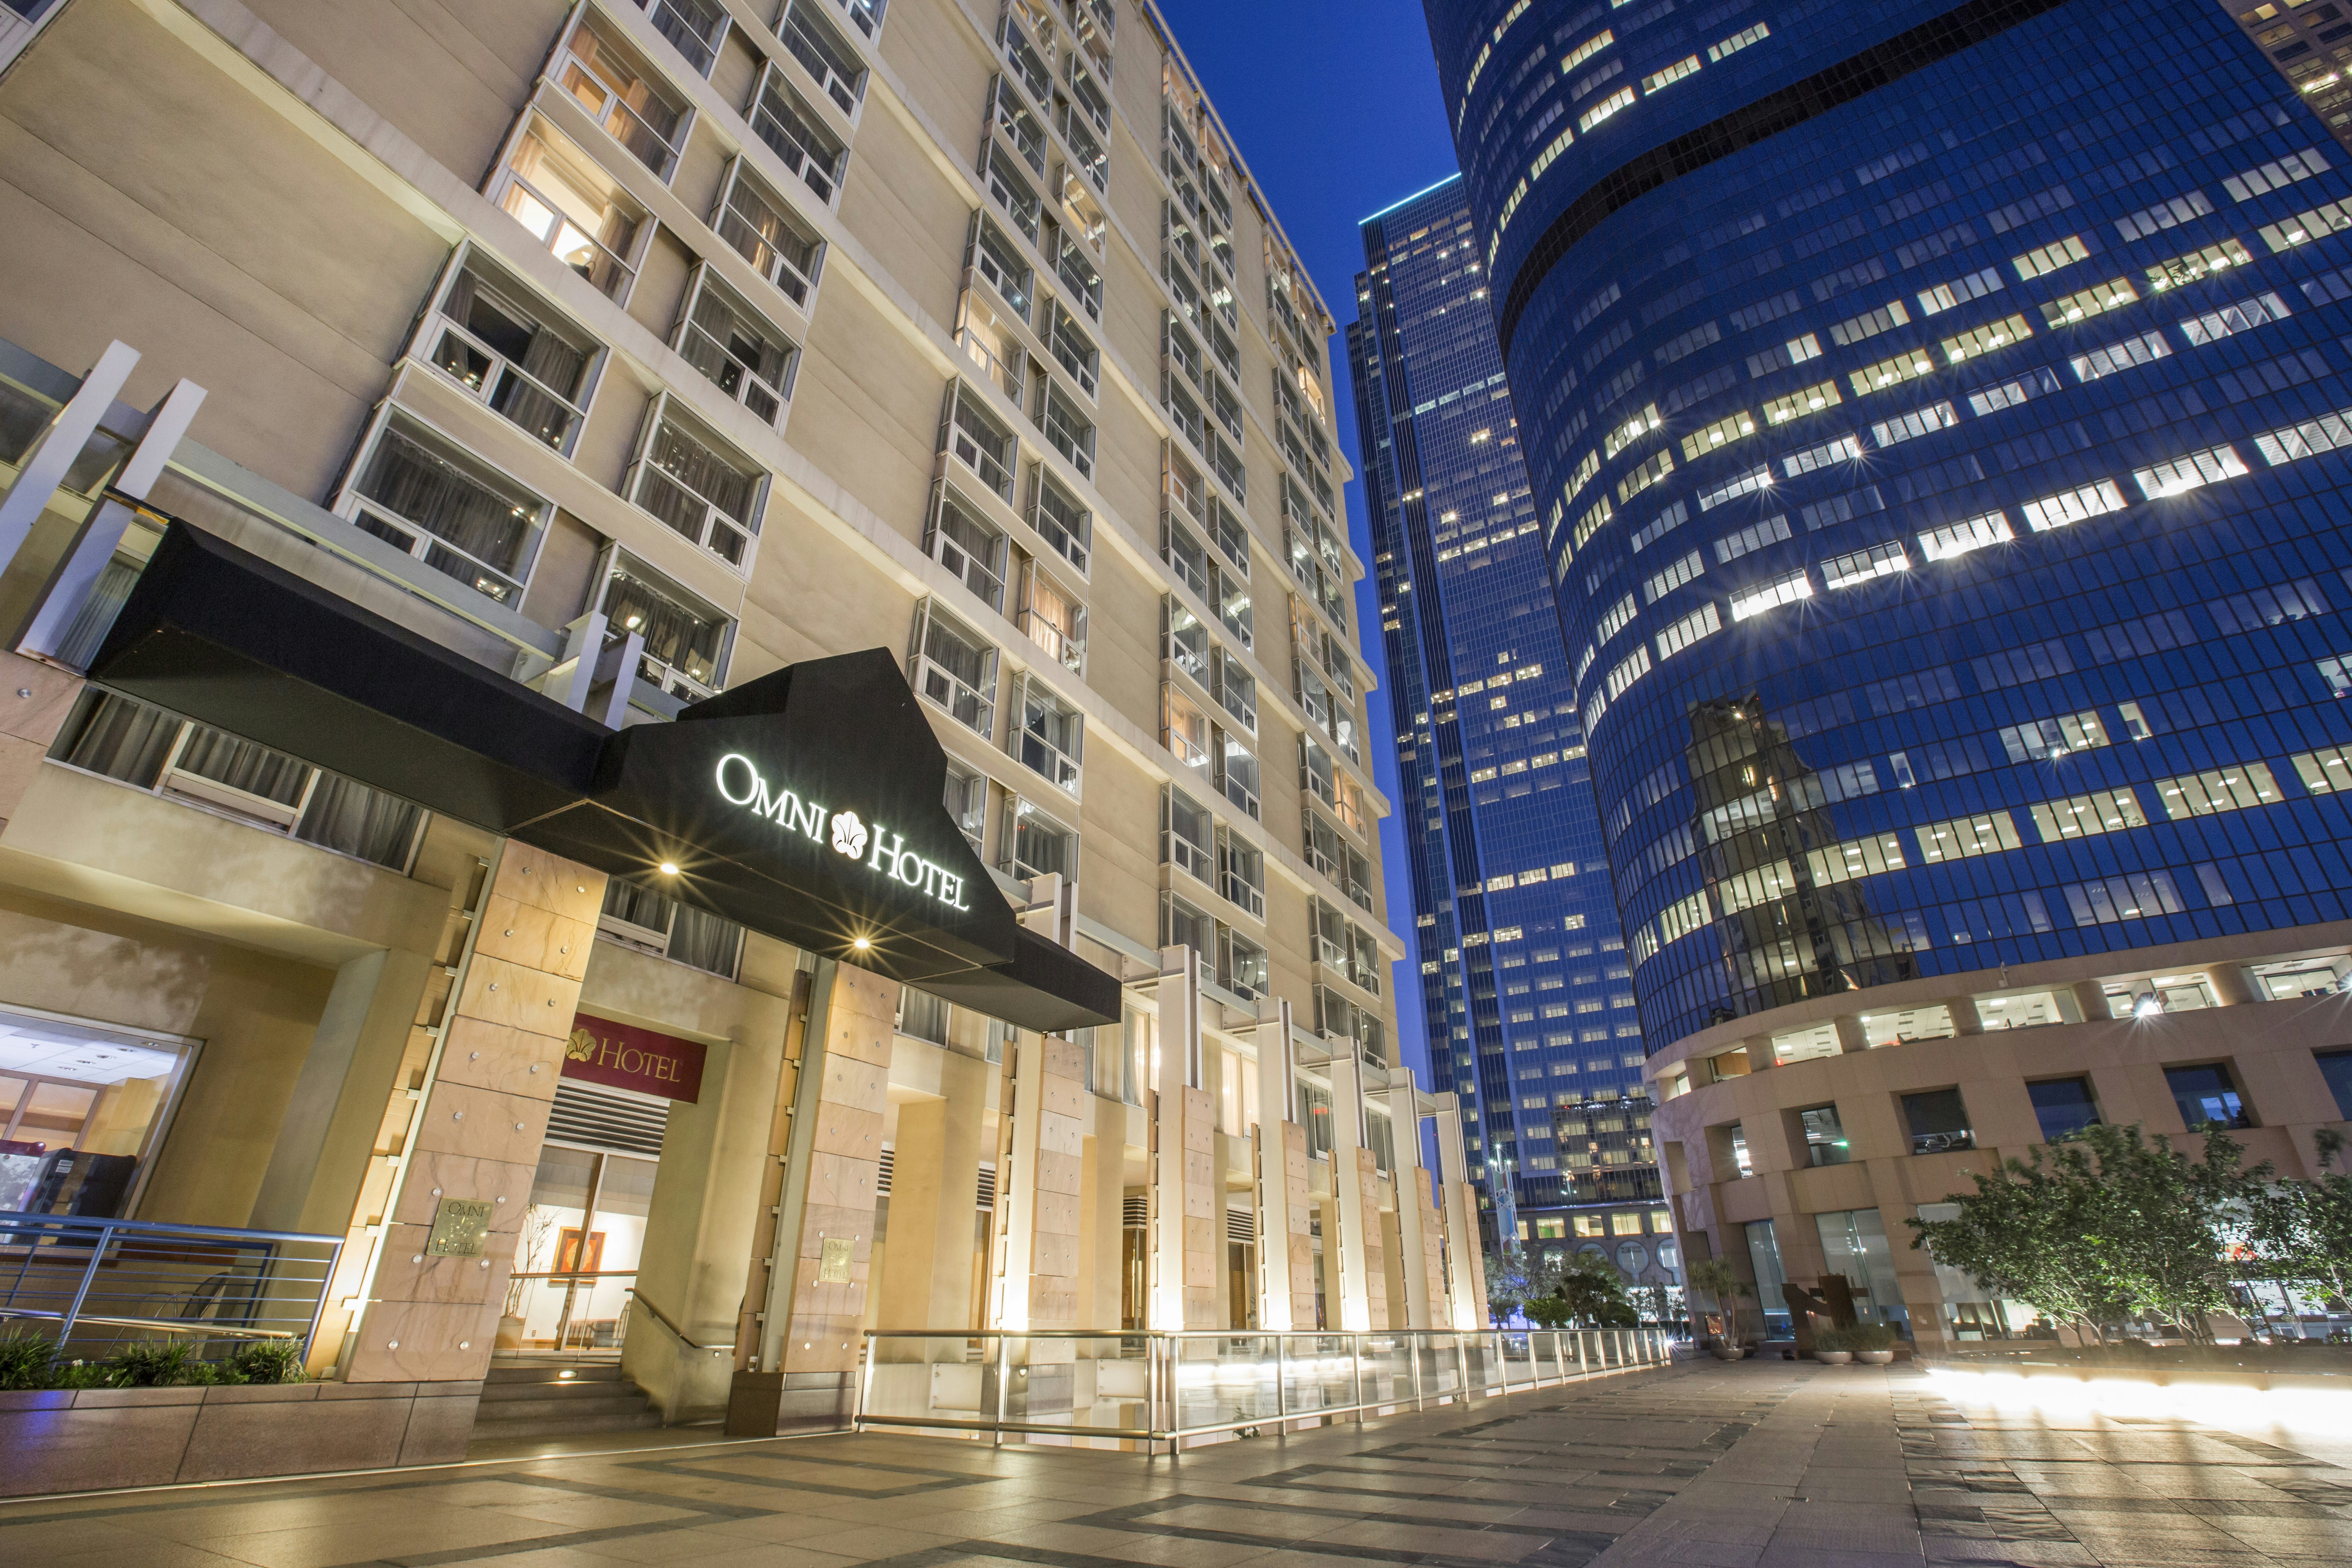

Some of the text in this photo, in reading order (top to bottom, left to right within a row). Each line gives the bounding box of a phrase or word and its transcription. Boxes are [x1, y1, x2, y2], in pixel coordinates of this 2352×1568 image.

[716, 754, 969, 911] OMNI HOTEL
[597, 1038, 681, 1082] HOTEL
[448, 1202, 485, 1217] OMNI
[435, 1238, 477, 1254] HOTEL
[829, 1241, 849, 1252] OMNI
[824, 1269, 846, 1280] HOTEL
